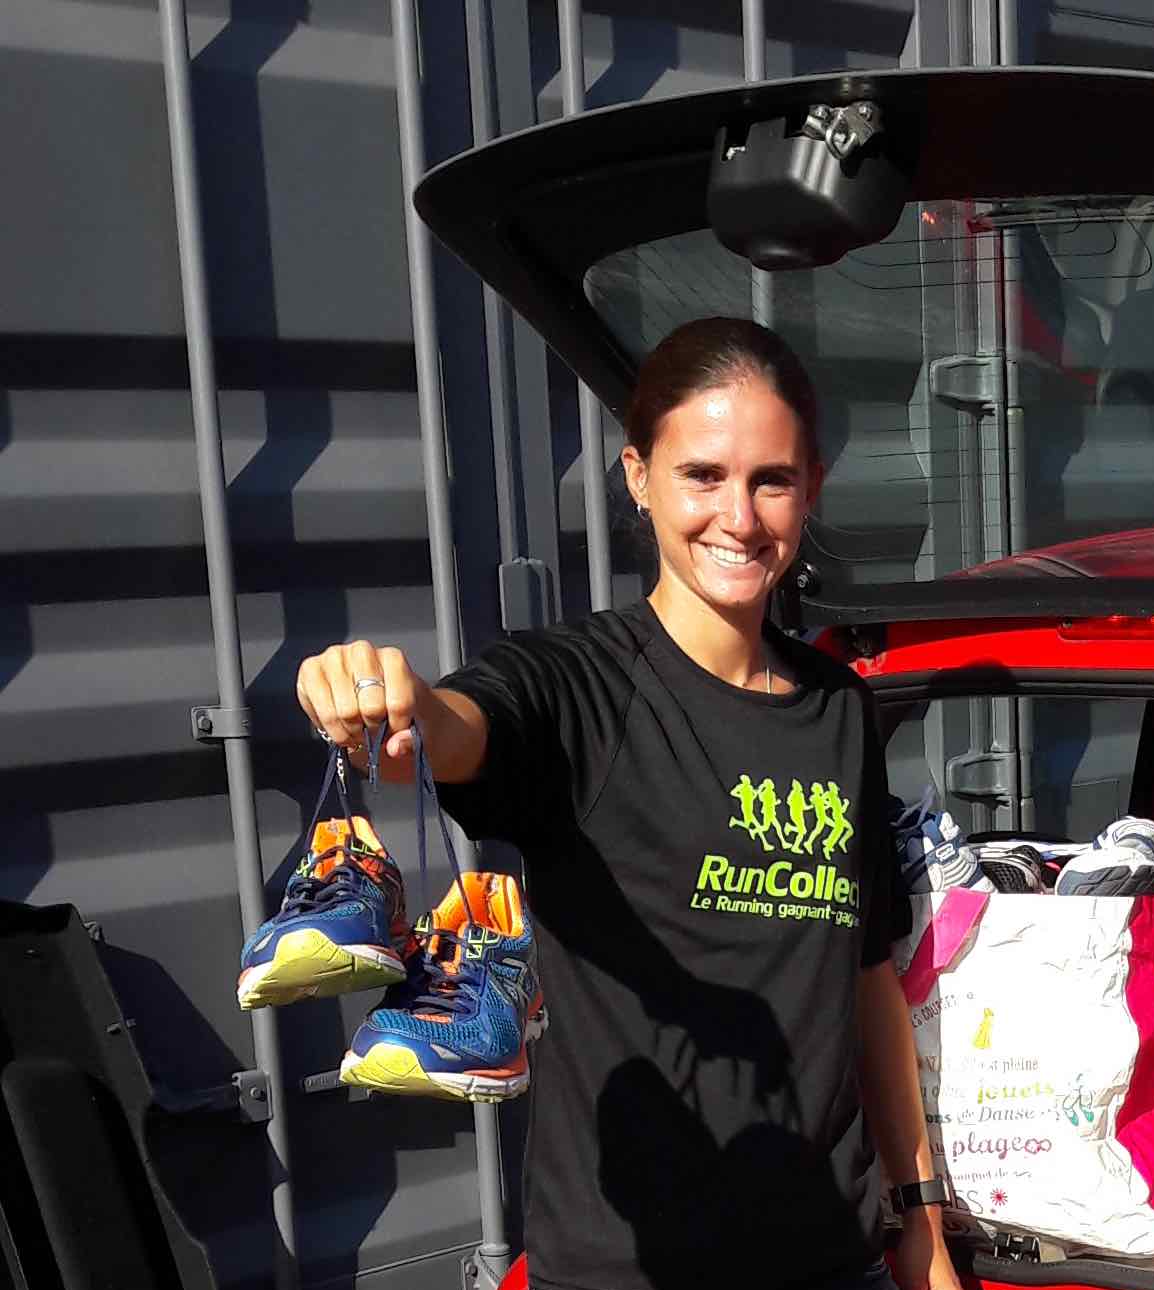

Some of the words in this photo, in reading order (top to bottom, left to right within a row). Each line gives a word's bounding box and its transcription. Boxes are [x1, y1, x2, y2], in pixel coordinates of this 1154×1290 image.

[695, 854, 860, 911] RunCollec
[690, 892, 712, 909] Le
[716, 895, 773, 917] Running
